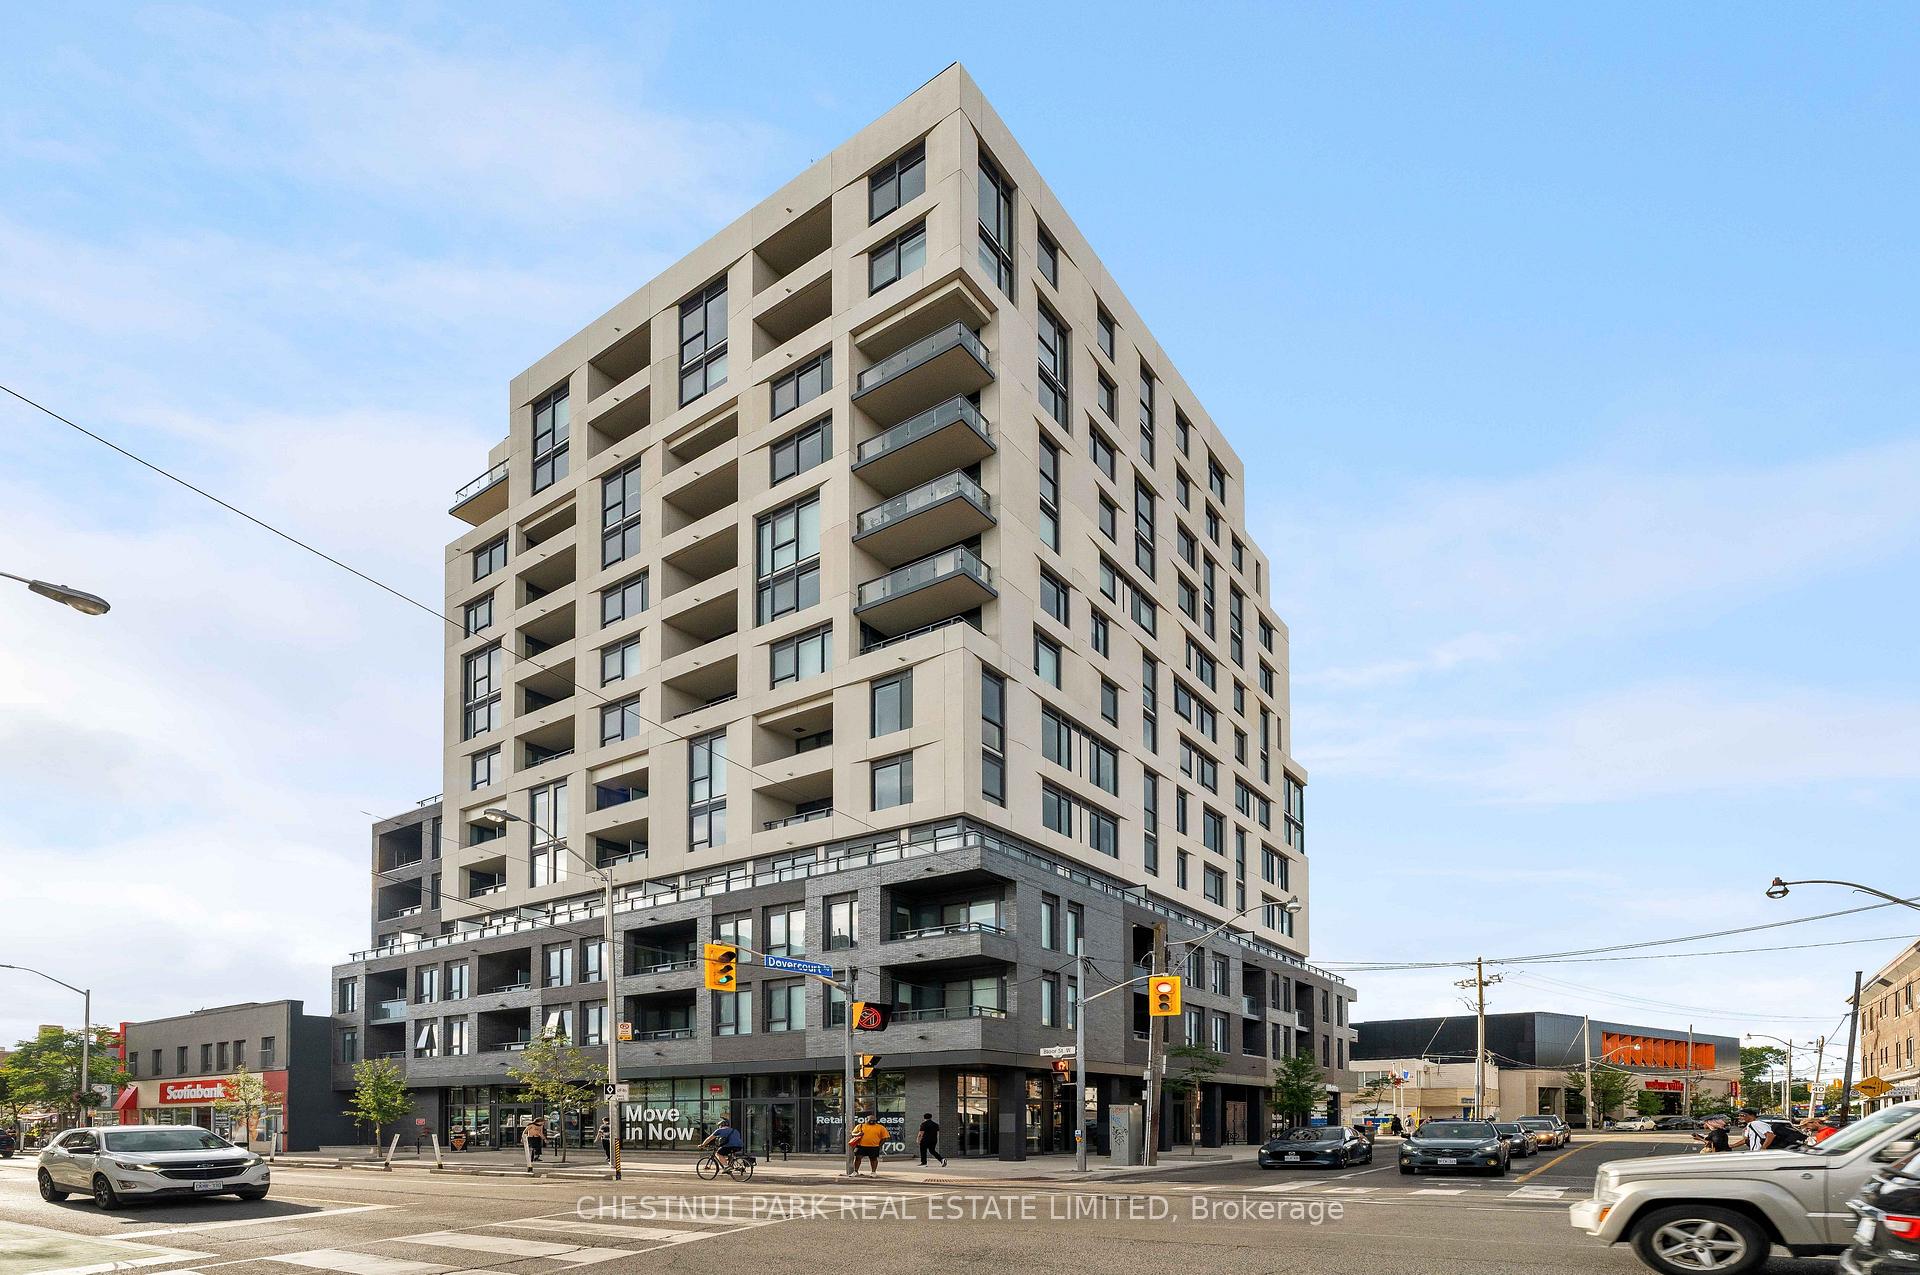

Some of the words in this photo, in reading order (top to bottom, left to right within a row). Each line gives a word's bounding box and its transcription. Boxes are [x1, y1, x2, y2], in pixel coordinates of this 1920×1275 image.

[768, 956, 821, 974] Dovercourt
[166, 1083, 226, 1100] Scotiabank
[625, 1104, 681, 1123] Move
[877, 1116, 905, 1124] ease
[625, 1122, 643, 1141] in
[648, 1123, 695, 1141] Now
